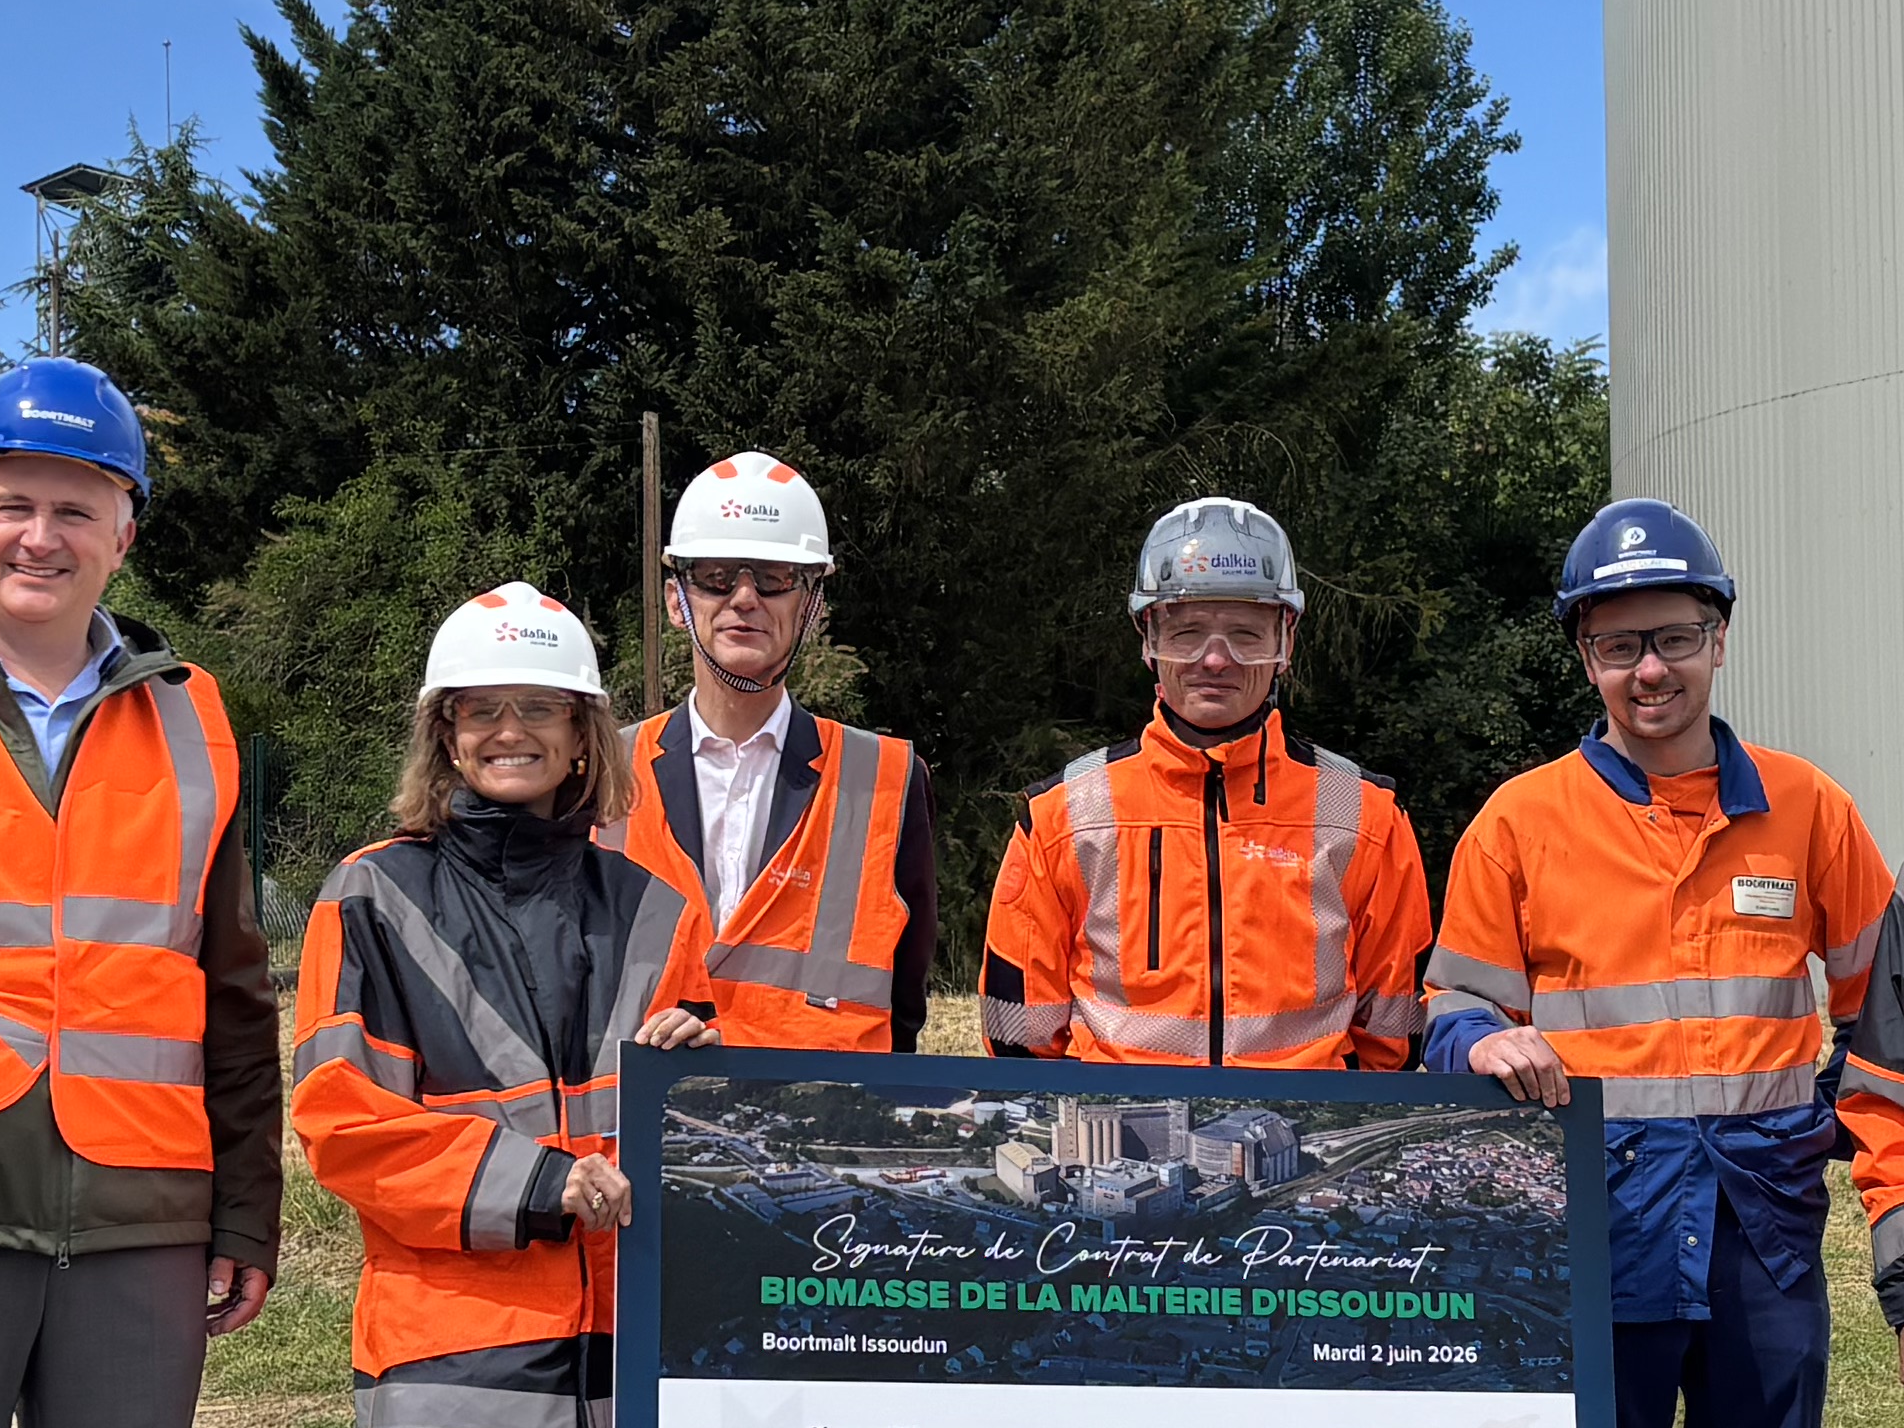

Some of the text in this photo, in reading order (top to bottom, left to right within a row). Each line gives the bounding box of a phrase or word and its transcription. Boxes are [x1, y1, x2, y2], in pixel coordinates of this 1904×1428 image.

[1211, 553, 1257, 568] dalkia
[812, 1214, 975, 1272] Signature
[1036, 1221, 1188, 1278] Contrat
[1183, 1240, 1223, 1265] de
[760, 1276, 1476, 1320] BIOMASSE DE LA MALTERIE D'ISSOUDUN
[762, 1332, 948, 1354] Boortmalt Issoudun
[1313, 1343, 1479, 1367] Mardi 2 juin 2026
